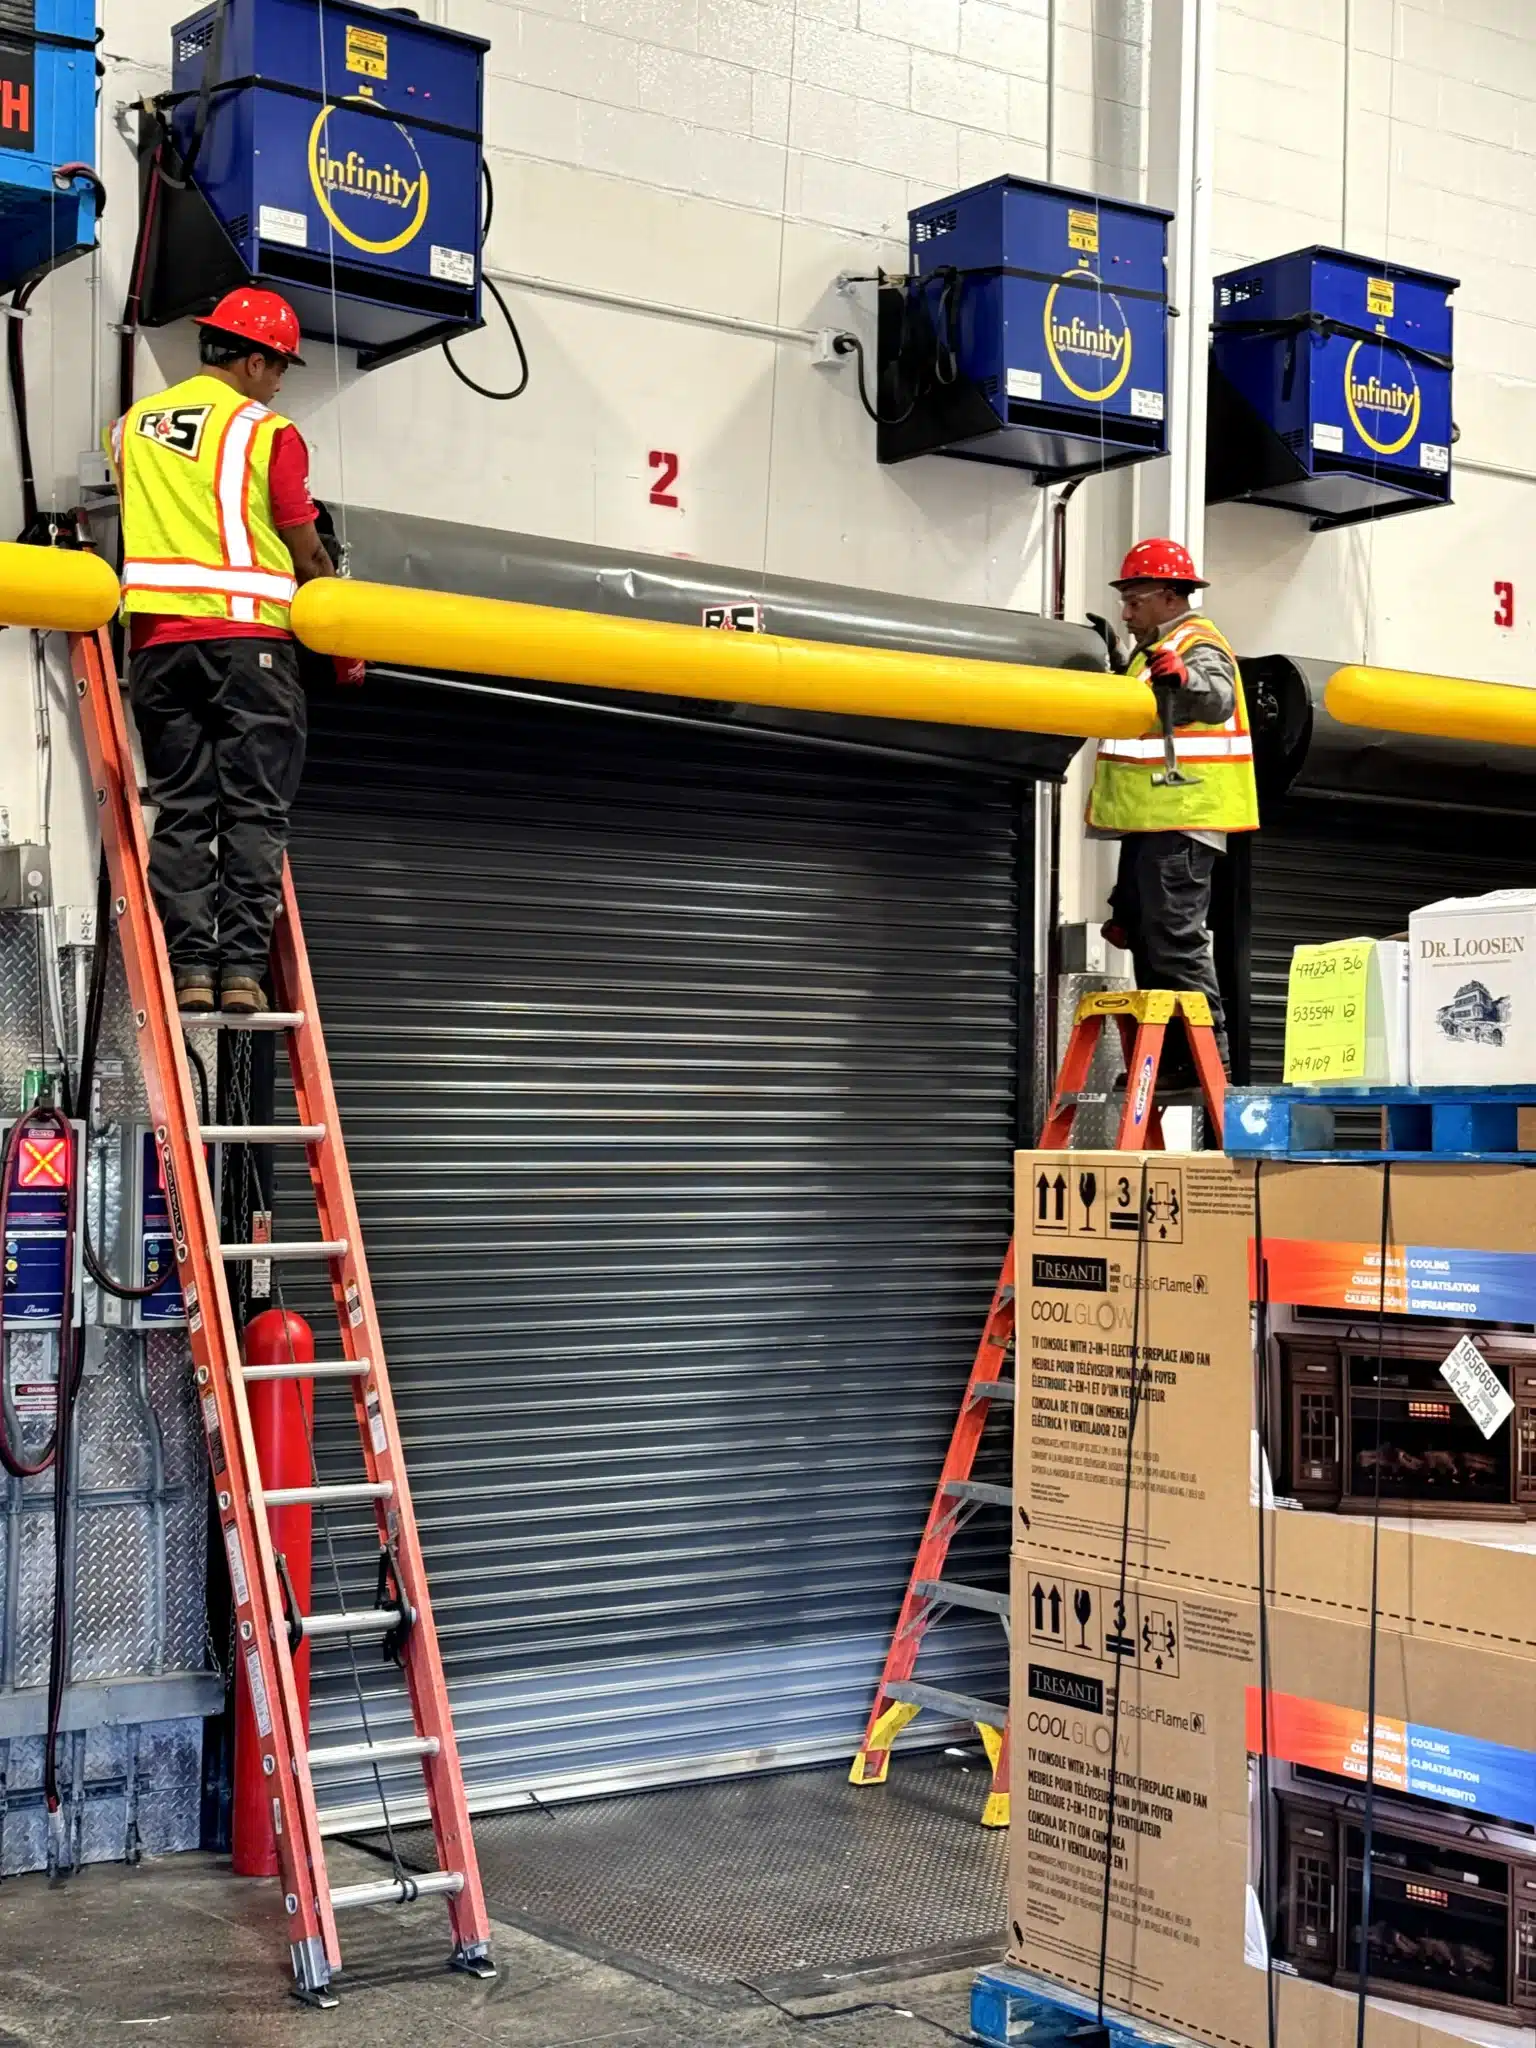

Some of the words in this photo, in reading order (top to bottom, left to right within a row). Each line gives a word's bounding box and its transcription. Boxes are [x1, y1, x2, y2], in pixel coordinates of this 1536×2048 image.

[320, 147, 419, 208] infinity
[1052, 316, 1124, 360] infinity
[1351, 375, 1414, 416] infinity
[139, 407, 205, 451] R&S
[648, 450, 678, 508] 2
[1494, 581, 1513, 627] 3
[1420, 940, 1450, 958] DR.
[1453, 936, 1525, 957] LOOSEN
[1343, 955, 1363, 971] 36
[1293, 1005, 1335, 1022] 535594
[1343, 1003, 1356, 1018] 12
[1290, 1056, 1330, 1072] 249109
[1342, 1047, 1356, 1063] 12
[1118, 1177, 1130, 1207] 3
[1036, 1260, 1102, 1281] TRESANTI
[1410, 1259, 1450, 1270] COOLING
[1123, 1274, 1192, 1293] ClassicFlame
[1411, 1280, 1480, 1293] CLIMATISATION
[1032, 1336, 1039, 1349] TV
[1040, 1337, 1068, 1351] CONSOLE
[1070, 1340, 1087, 1353] WITH
[1089, 1341, 1109, 1355] 2-IN-1
[1142, 1347, 1178, 1363] FIREPLACE
[1180, 1351, 1195, 1364] AND
[1197, 1352, 1211, 1366] FAN
[1032, 1357, 1055, 1371] MEUBLE
[1056, 1359, 1074, 1373] POUR
[1076, 1360, 1114, 1378] TÉLÉVISEUR
[1154, 1370, 1177, 1386] FOYER
[1460, 1341, 1500, 1398] 1656669
[1068, 1379, 1091, 1394] 2-EN-1
[1092, 1382, 1100, 1395] ET
[1101, 1383, 1119, 1397] D'UN
[1032, 1396, 1058, 1411] CONSOLA
[1060, 1399, 1069, 1412] DE
[1071, 1401, 1079, 1414] TV
[1080, 1402, 1094, 1416] CON
[1096, 1403, 1129, 1420] CHIMENEA
[1032, 1413, 1062, 1430] ELÉCTRICA
[1064, 1418, 1068, 1431] Y
[1070, 1419, 1110, 1437] VENTILADOR
[1112, 1425, 1117, 1437] 2
[1119, 1425, 1127, 1438] EN
[1113, 1600, 1126, 1631] 3
[1032, 1670, 1098, 1703] TRESANTI
[1119, 1700, 1189, 1730] ClassicFlame
[1411, 1737, 1450, 1755] COOLING
[1028, 1747, 1037, 1761] TV
[1038, 1750, 1066, 1769] CONSOLE
[1068, 1758, 1084, 1774] WITH
[1086, 1763, 1106, 1781] 2-IN-1
[1108, 1769, 1137, 1789] EECTRIC
[1138, 1777, 1174, 1800] FIREPLACE
[1176, 1788, 1191, 1804] AND
[1193, 1792, 1208, 1808] FAN
[1028, 1769, 1053, 1787] MEUBLE
[1055, 1776, 1073, 1792] POUR
[1131, 1798, 1149, 1815] D'UN
[1151, 1803, 1173, 1822] FOYER
[1028, 1786, 1065, 1809] ÉLECTRIQUE
[1066, 1799, 1087, 1817] 2-EN-1
[1089, 1805, 1097, 1820] ET
[1116, 1813, 1161, 1839] VENTILATEUR
[1028, 1809, 1058, 1829] CONSOLA
[1058, 1816, 1067, 1831] DE
[1068, 1820, 1076, 1835] TV
[1078, 1824, 1090, 1840] CON
[1028, 1827, 1060, 1849] ELÉCTRICA
[1062, 1835, 1066, 1851] Y
[1067, 1840, 1107, 1864] VENTILADOR
[1114, 1855, 1123, 1870] EN
[1125, 1857, 1128, 1872] 1
